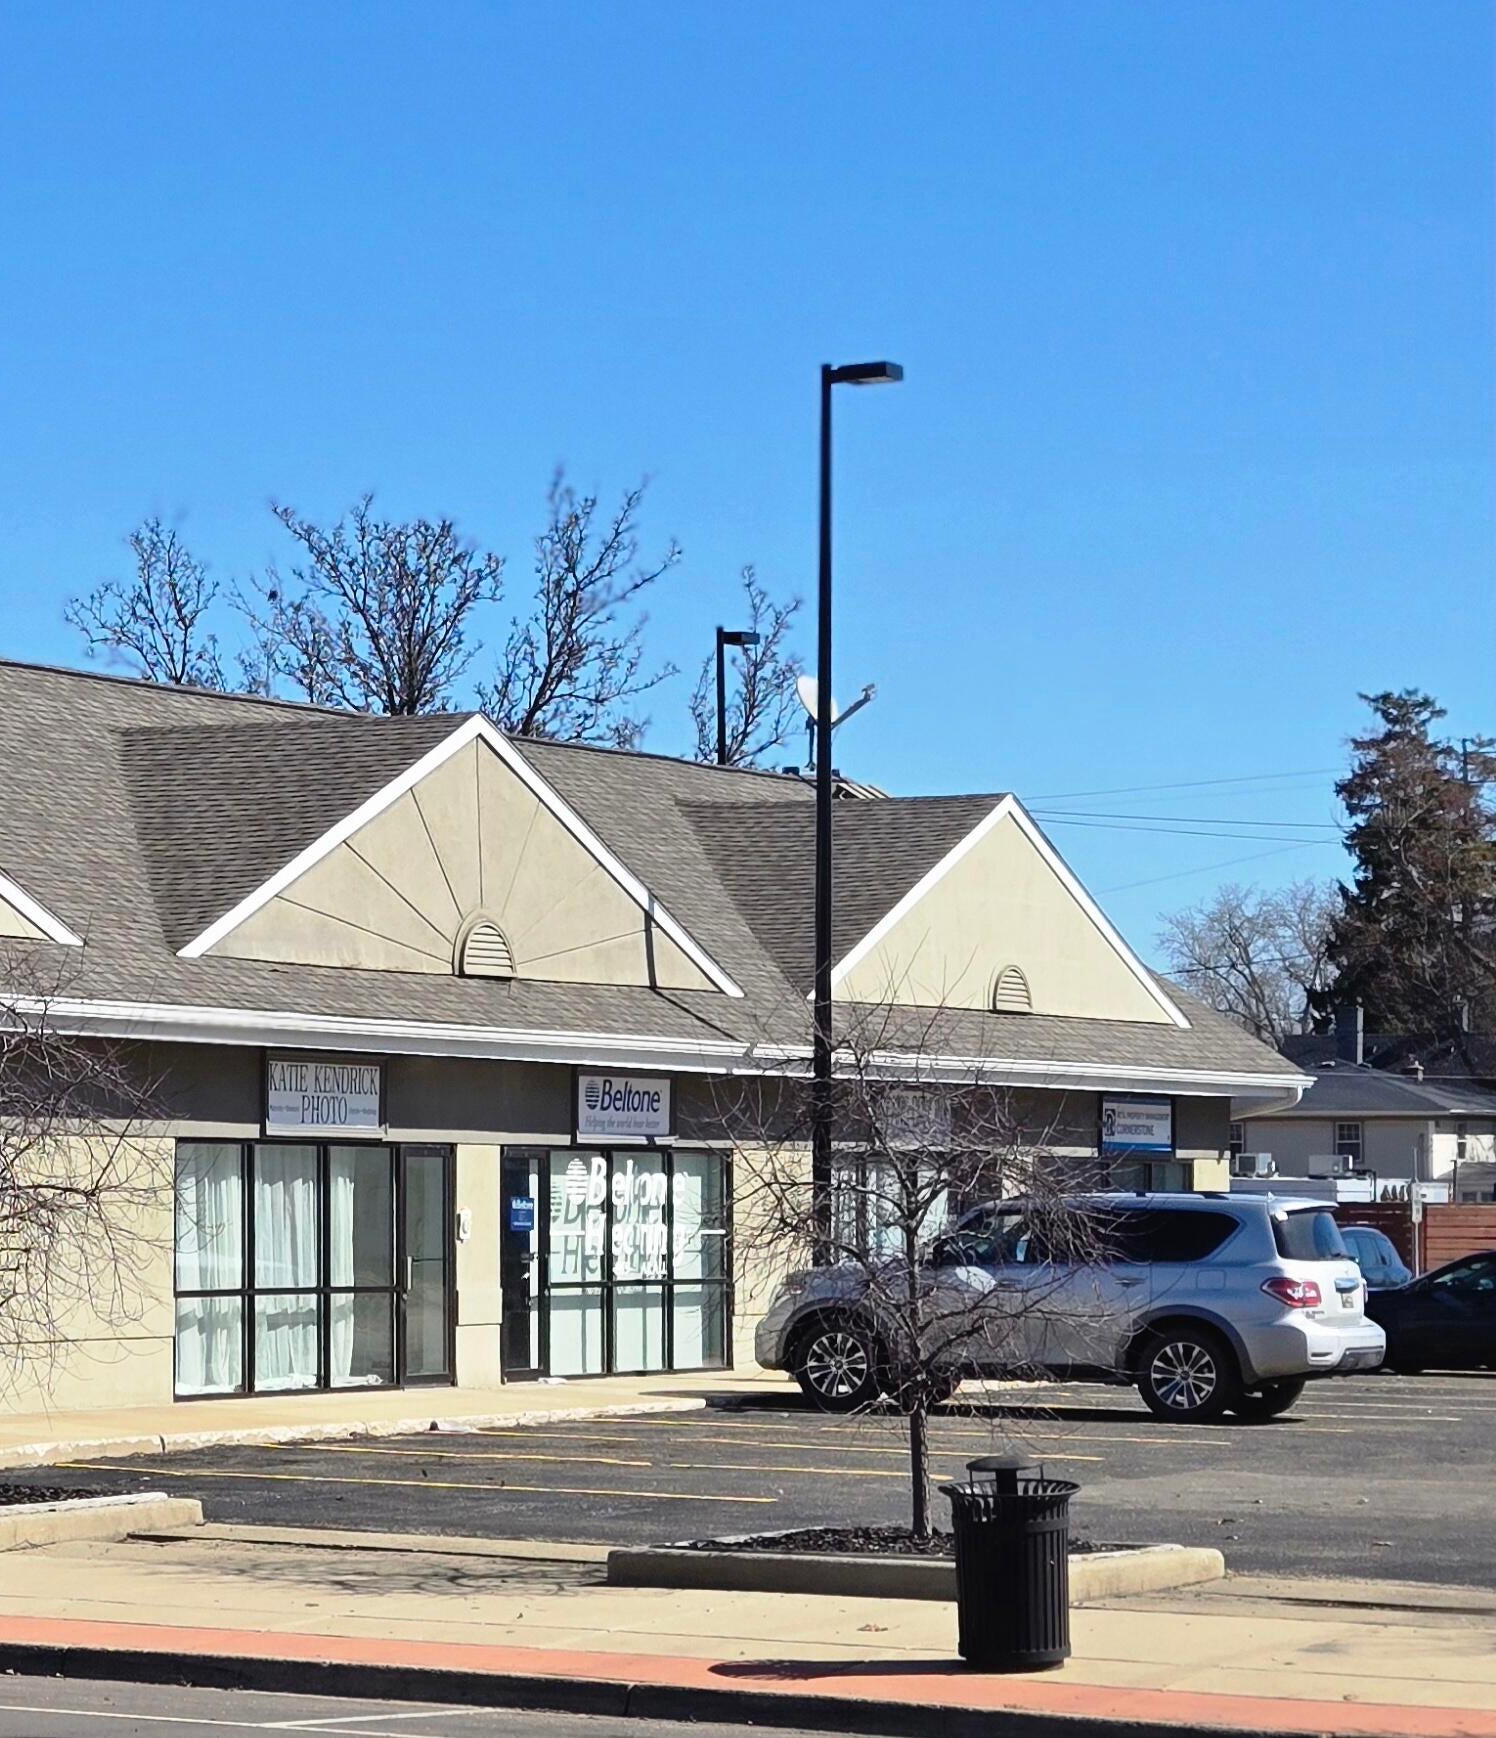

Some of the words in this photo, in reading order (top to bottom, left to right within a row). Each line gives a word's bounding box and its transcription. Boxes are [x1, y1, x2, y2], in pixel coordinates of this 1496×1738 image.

[268, 1063, 308, 1092] KATIE
[314, 1065, 379, 1095] KENDRICK
[301, 1095, 348, 1125] PHOTO
[600, 1079, 661, 1113] Beltone
